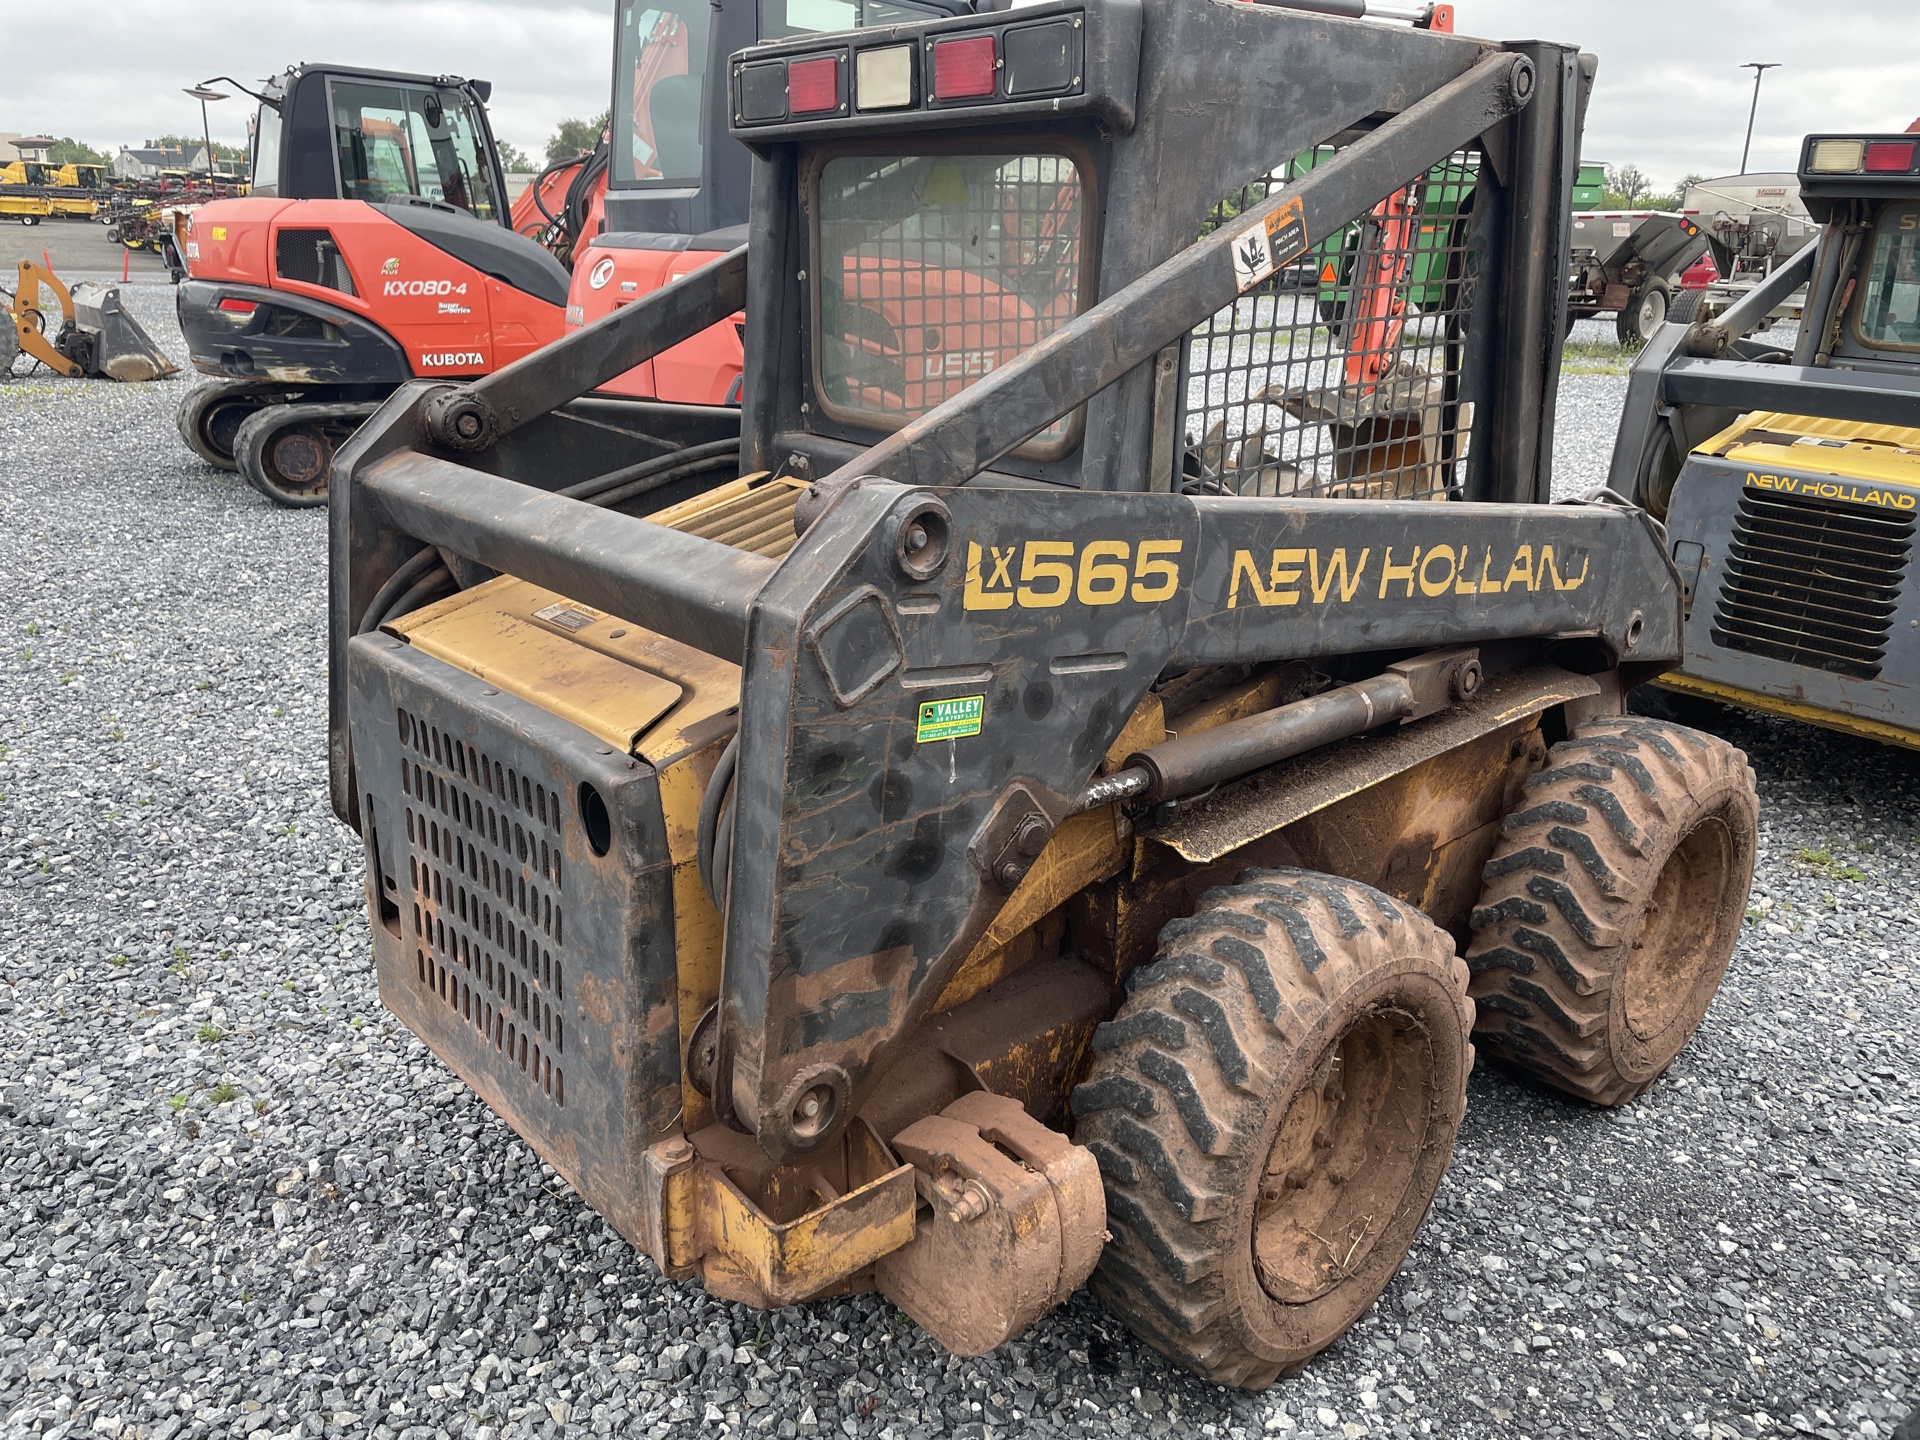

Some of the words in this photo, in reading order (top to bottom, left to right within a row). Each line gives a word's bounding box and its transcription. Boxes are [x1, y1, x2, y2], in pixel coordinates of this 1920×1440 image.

[1899, 213, 1920, 230] S
[1275, 234, 1288, 247] PINCH
[1288, 227, 1299, 238] AREA
[383, 280, 467, 296] KX080-4
[438, 302, 459, 310] Super
[421, 353, 484, 366] KUBOTA
[1746, 472, 1799, 492] NEW
[1802, 481, 1916, 509] HOLLAND
[963, 539, 1183, 610] LX565
[1227, 547, 1370, 609] NEW
[1378, 543, 1590, 599] HOLLAND
[937, 700, 980, 716] VALLEY
